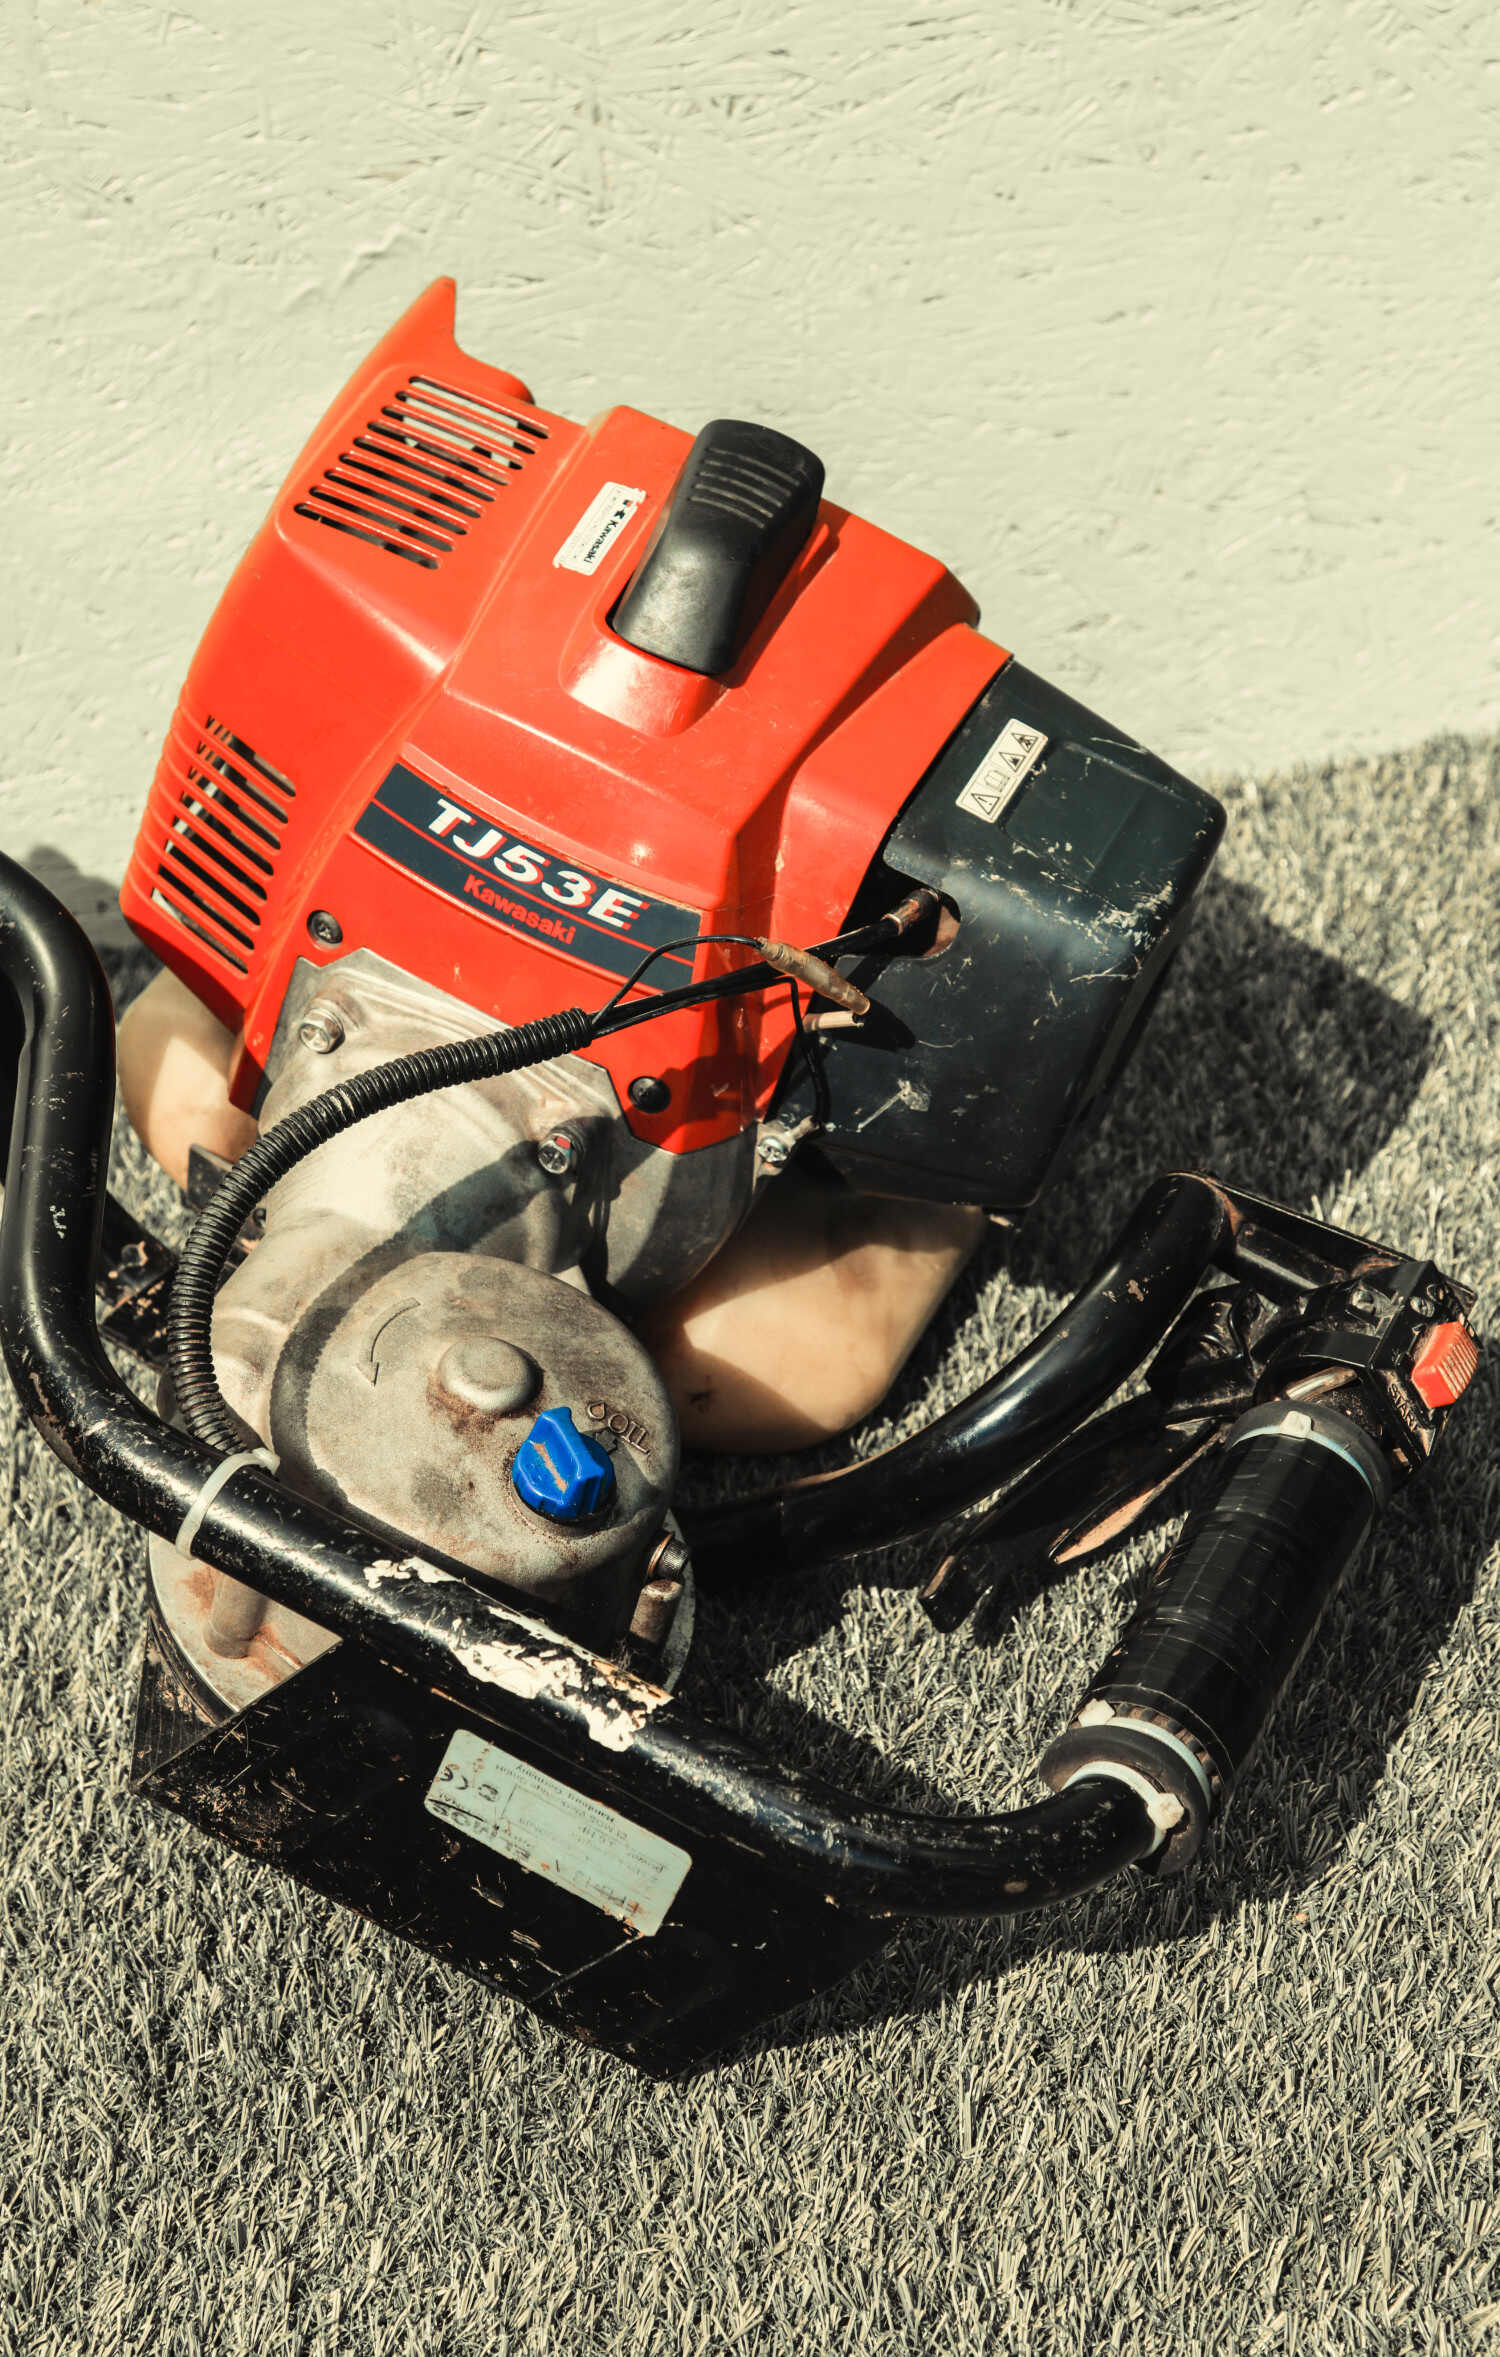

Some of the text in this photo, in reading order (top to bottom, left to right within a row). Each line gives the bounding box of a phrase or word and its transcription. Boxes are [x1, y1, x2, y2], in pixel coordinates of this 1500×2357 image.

[584, 519, 618, 564] Kawasaki
[428, 798, 650, 931] TJ53E
[463, 873, 577, 945] Kawasaki
[607, 1413, 649, 1454] OIL
